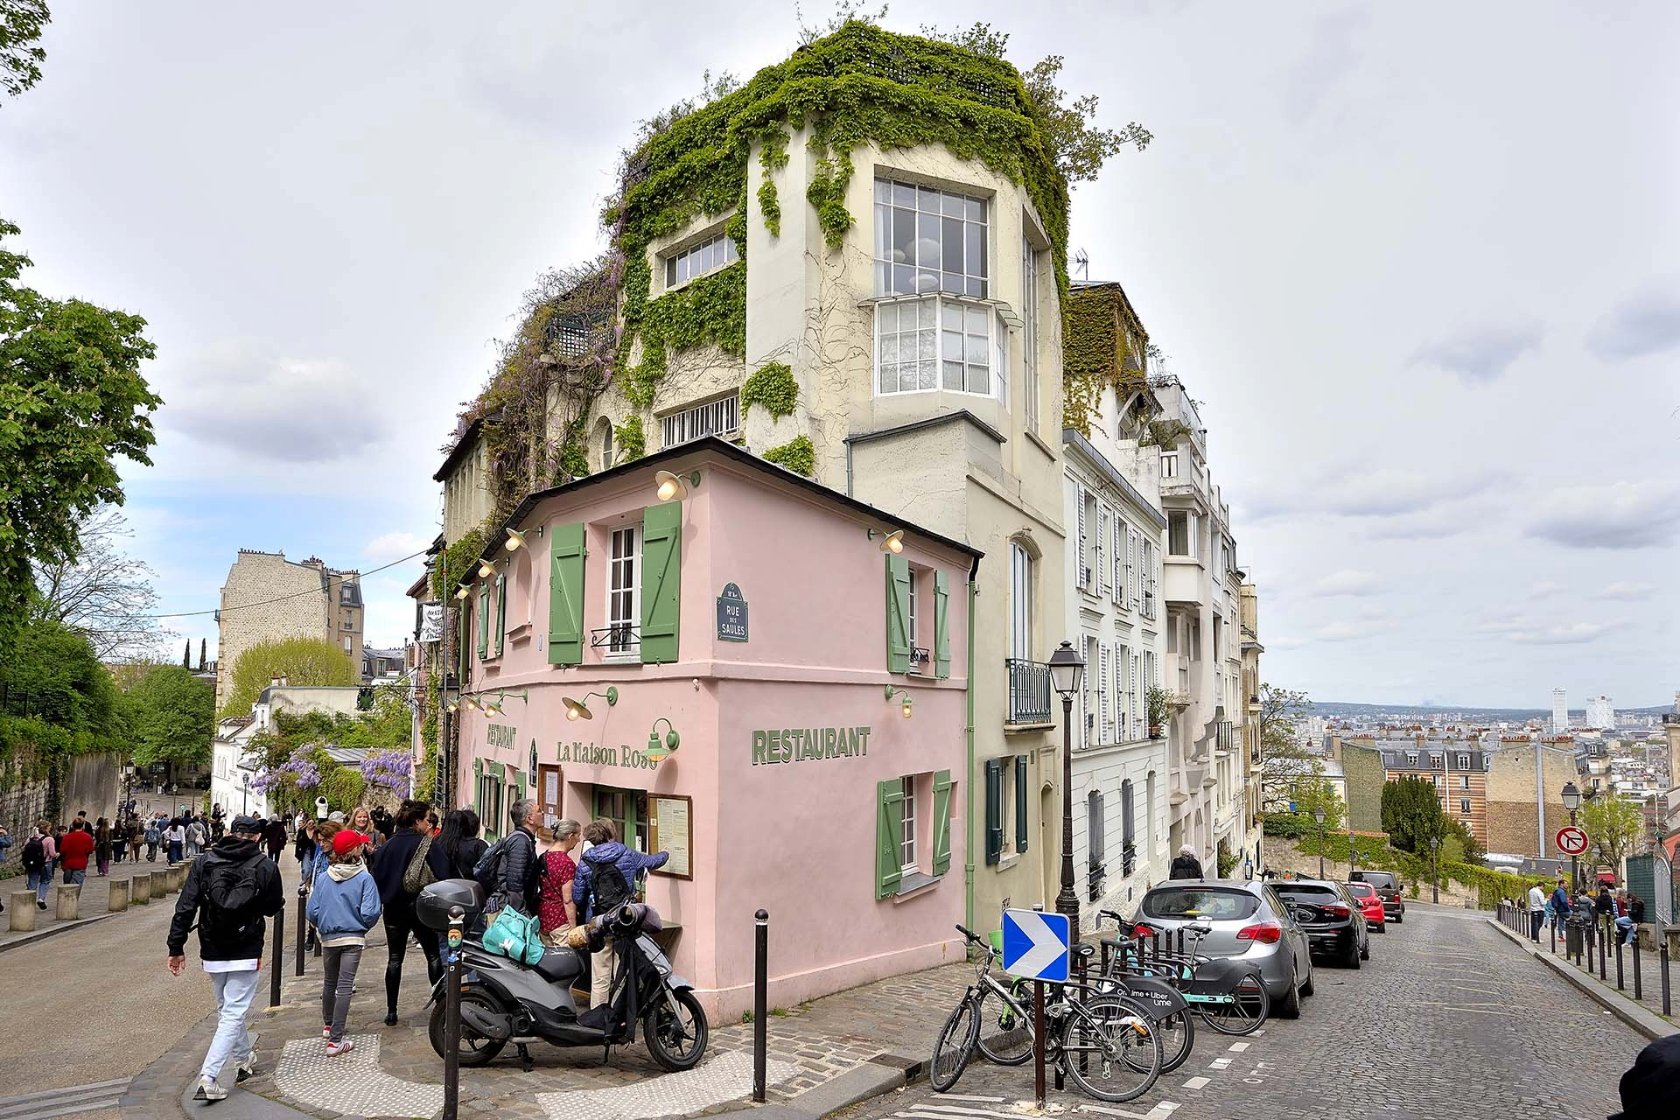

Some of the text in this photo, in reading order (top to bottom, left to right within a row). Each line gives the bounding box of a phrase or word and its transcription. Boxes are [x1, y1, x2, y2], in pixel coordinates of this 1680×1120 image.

[726, 605, 740, 617] RUE
[721, 623, 745, 636] SAULES
[487, 723, 517, 750] RESTAURANT
[752, 726, 871, 766] RESTAURANT
[556, 741, 571, 762] La
[572, 741, 618, 766] Maison
[1130, 989, 1144, 997] ime
[1151, 991, 1168, 999] Uber
